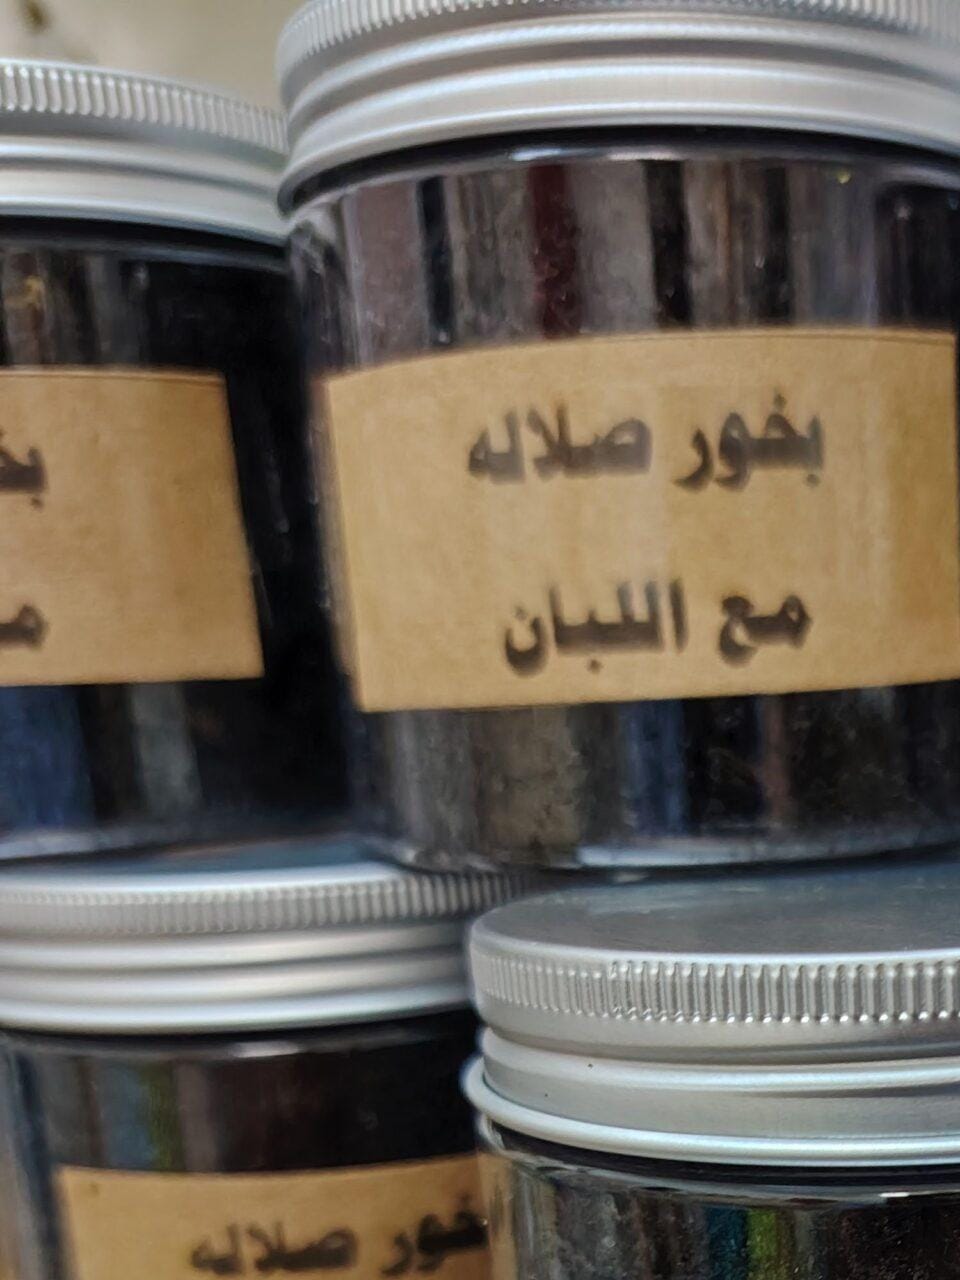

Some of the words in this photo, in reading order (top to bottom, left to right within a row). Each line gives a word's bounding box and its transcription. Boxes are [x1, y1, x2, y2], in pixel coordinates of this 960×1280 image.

[467, 398, 652, 485] صلاله
[673, 390, 824, 492] بخور
[504, 576, 690, 680] اللبان
[717, 595, 813, 669] مع
[190, 1220, 358, 1277] صلاله
